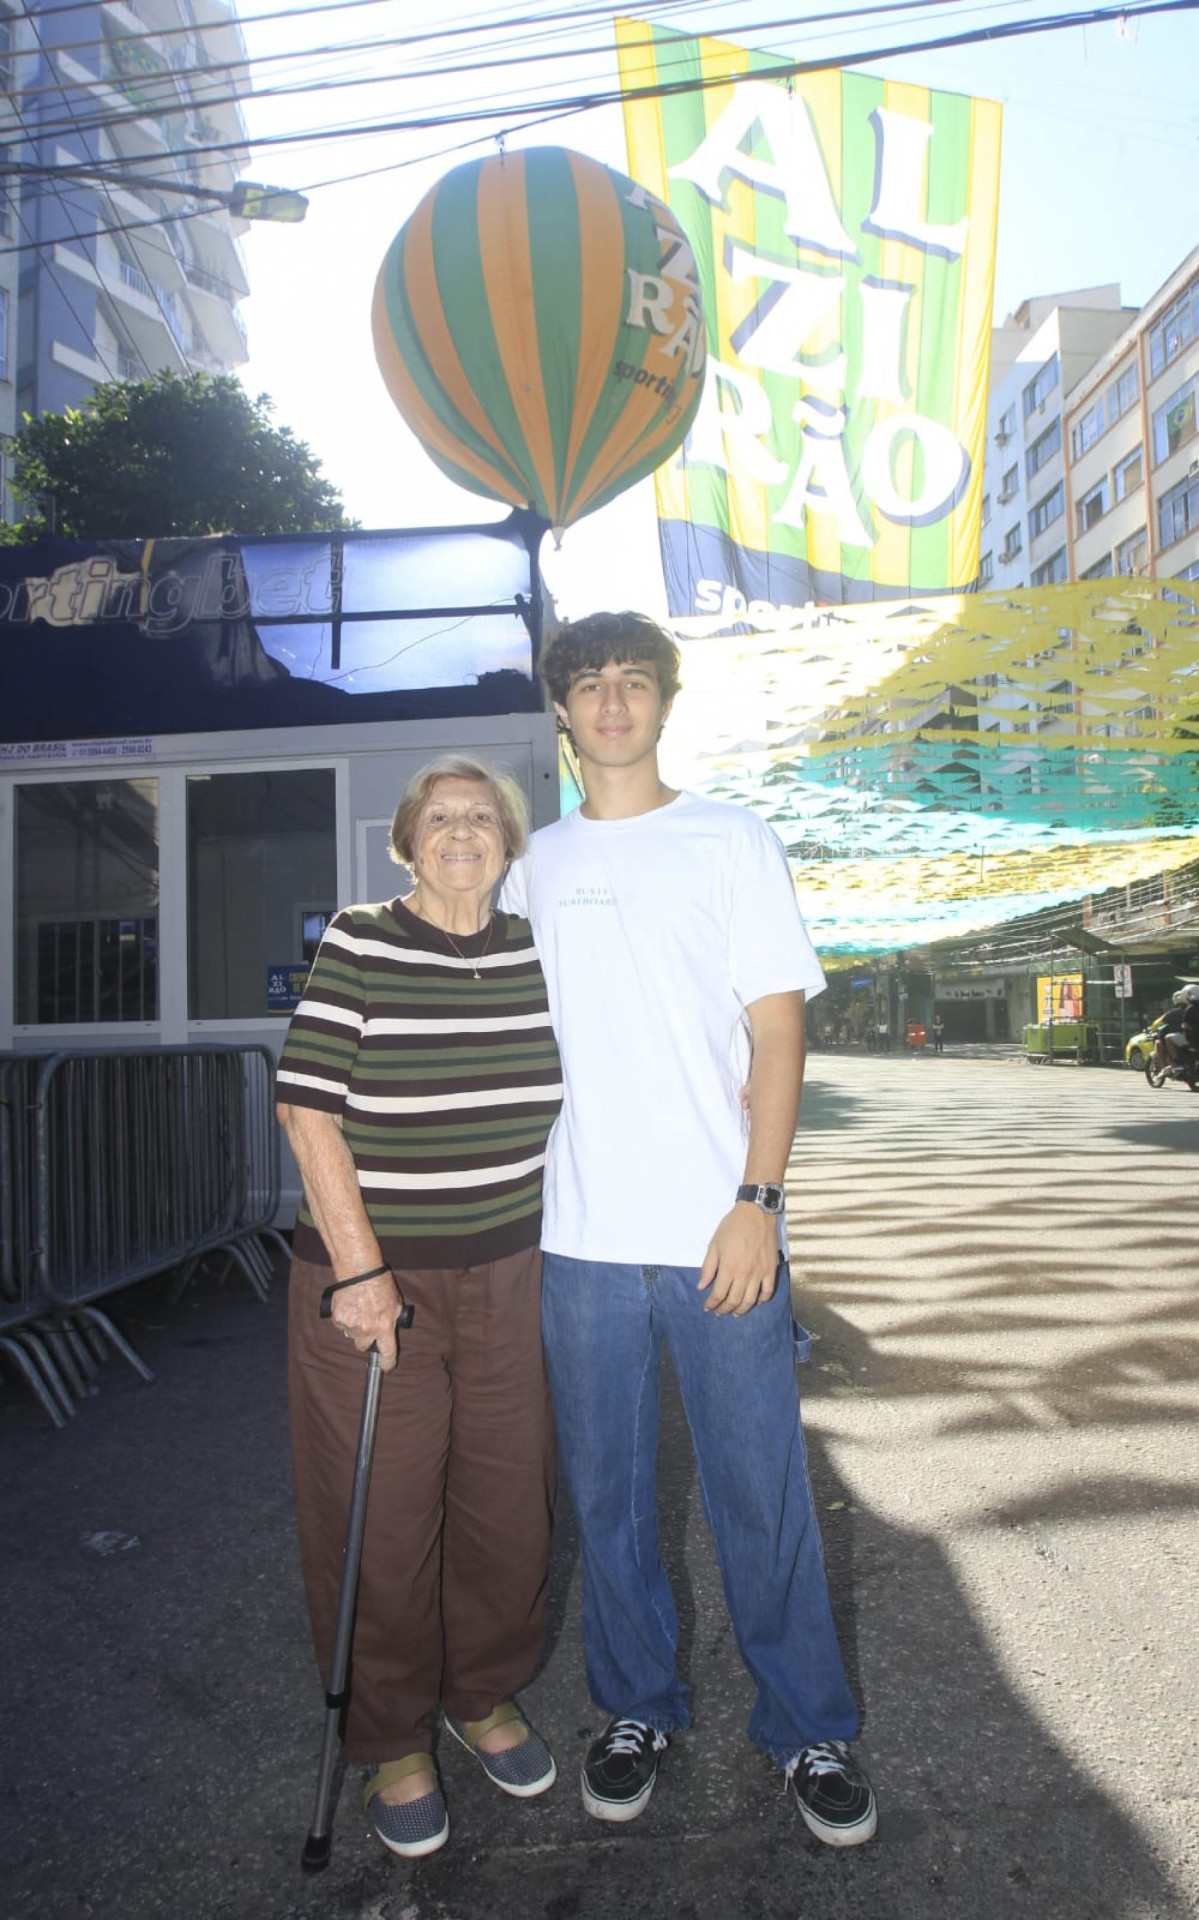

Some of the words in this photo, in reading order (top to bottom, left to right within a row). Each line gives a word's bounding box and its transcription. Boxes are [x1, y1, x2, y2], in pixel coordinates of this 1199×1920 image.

[668, 76, 968, 262] AL
[725, 240, 916, 400] ZI
[682, 356, 971, 547] RÃO
